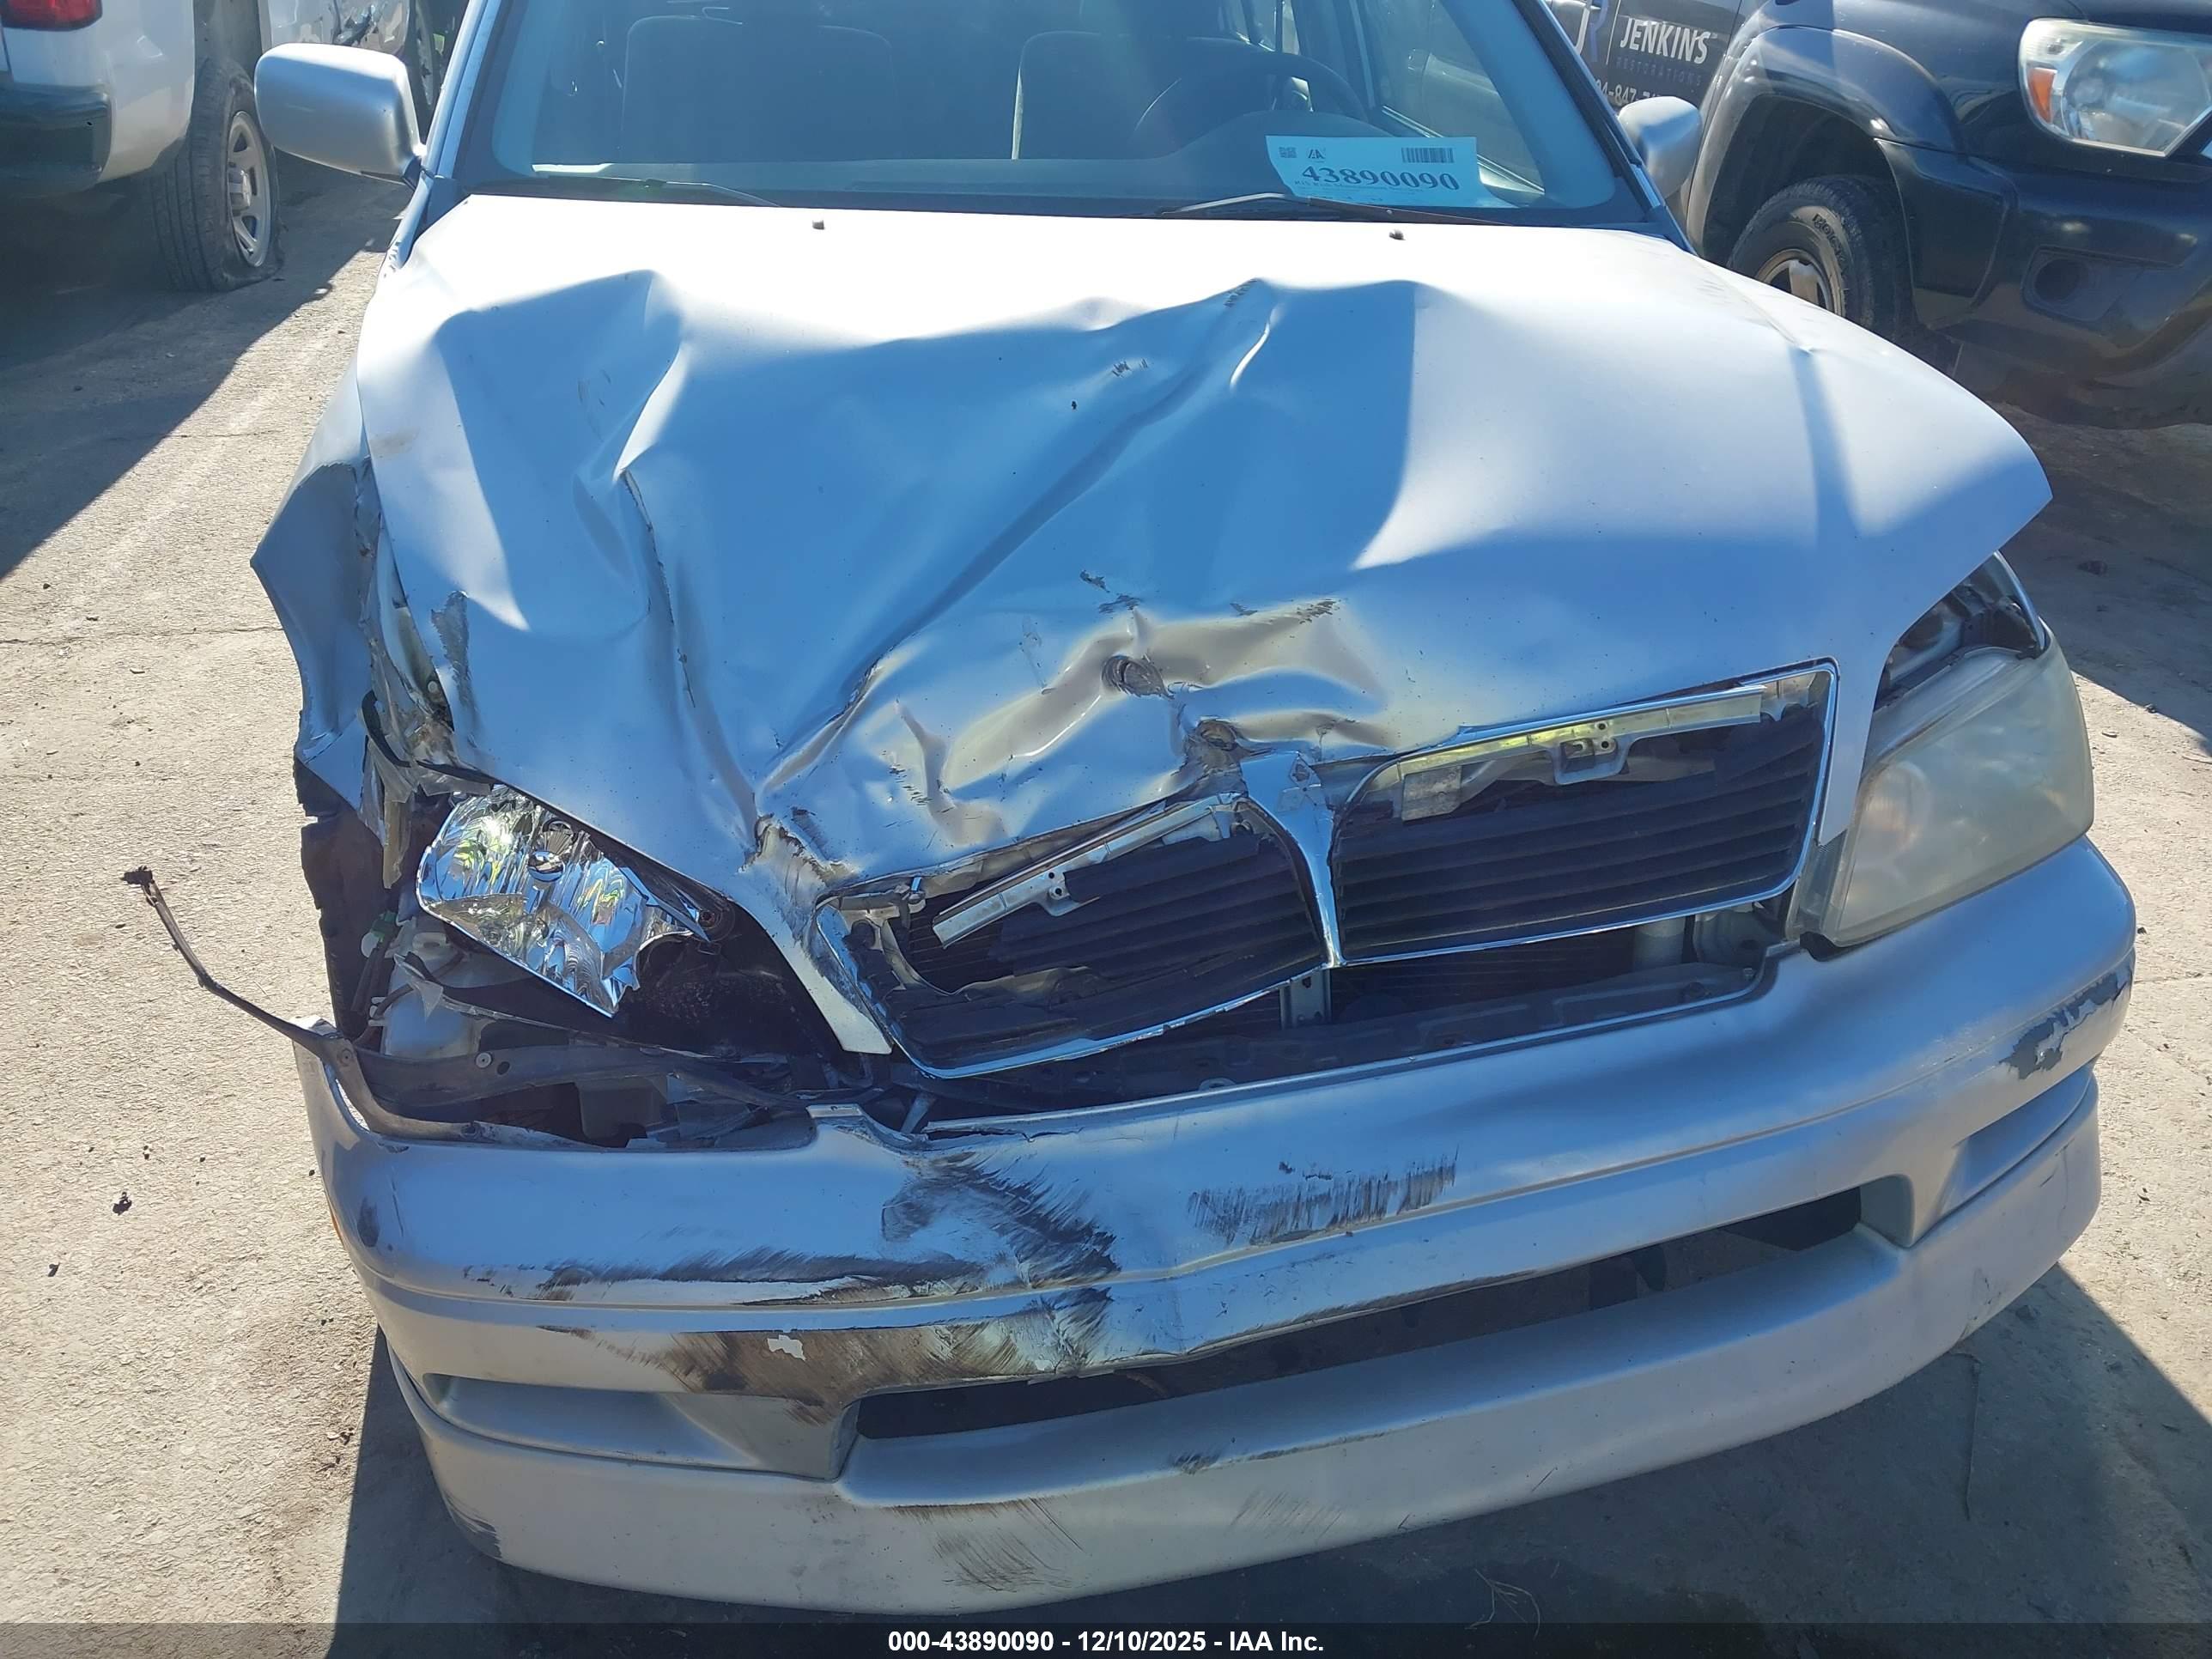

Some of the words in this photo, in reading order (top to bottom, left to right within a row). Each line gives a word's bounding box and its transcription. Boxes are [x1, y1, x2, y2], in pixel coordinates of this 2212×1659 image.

[1620, 15, 1711, 64] JENKINS
[1615, 56, 1702, 87] RESTORATIONS
[1302, 165, 1461, 191] 43890090
